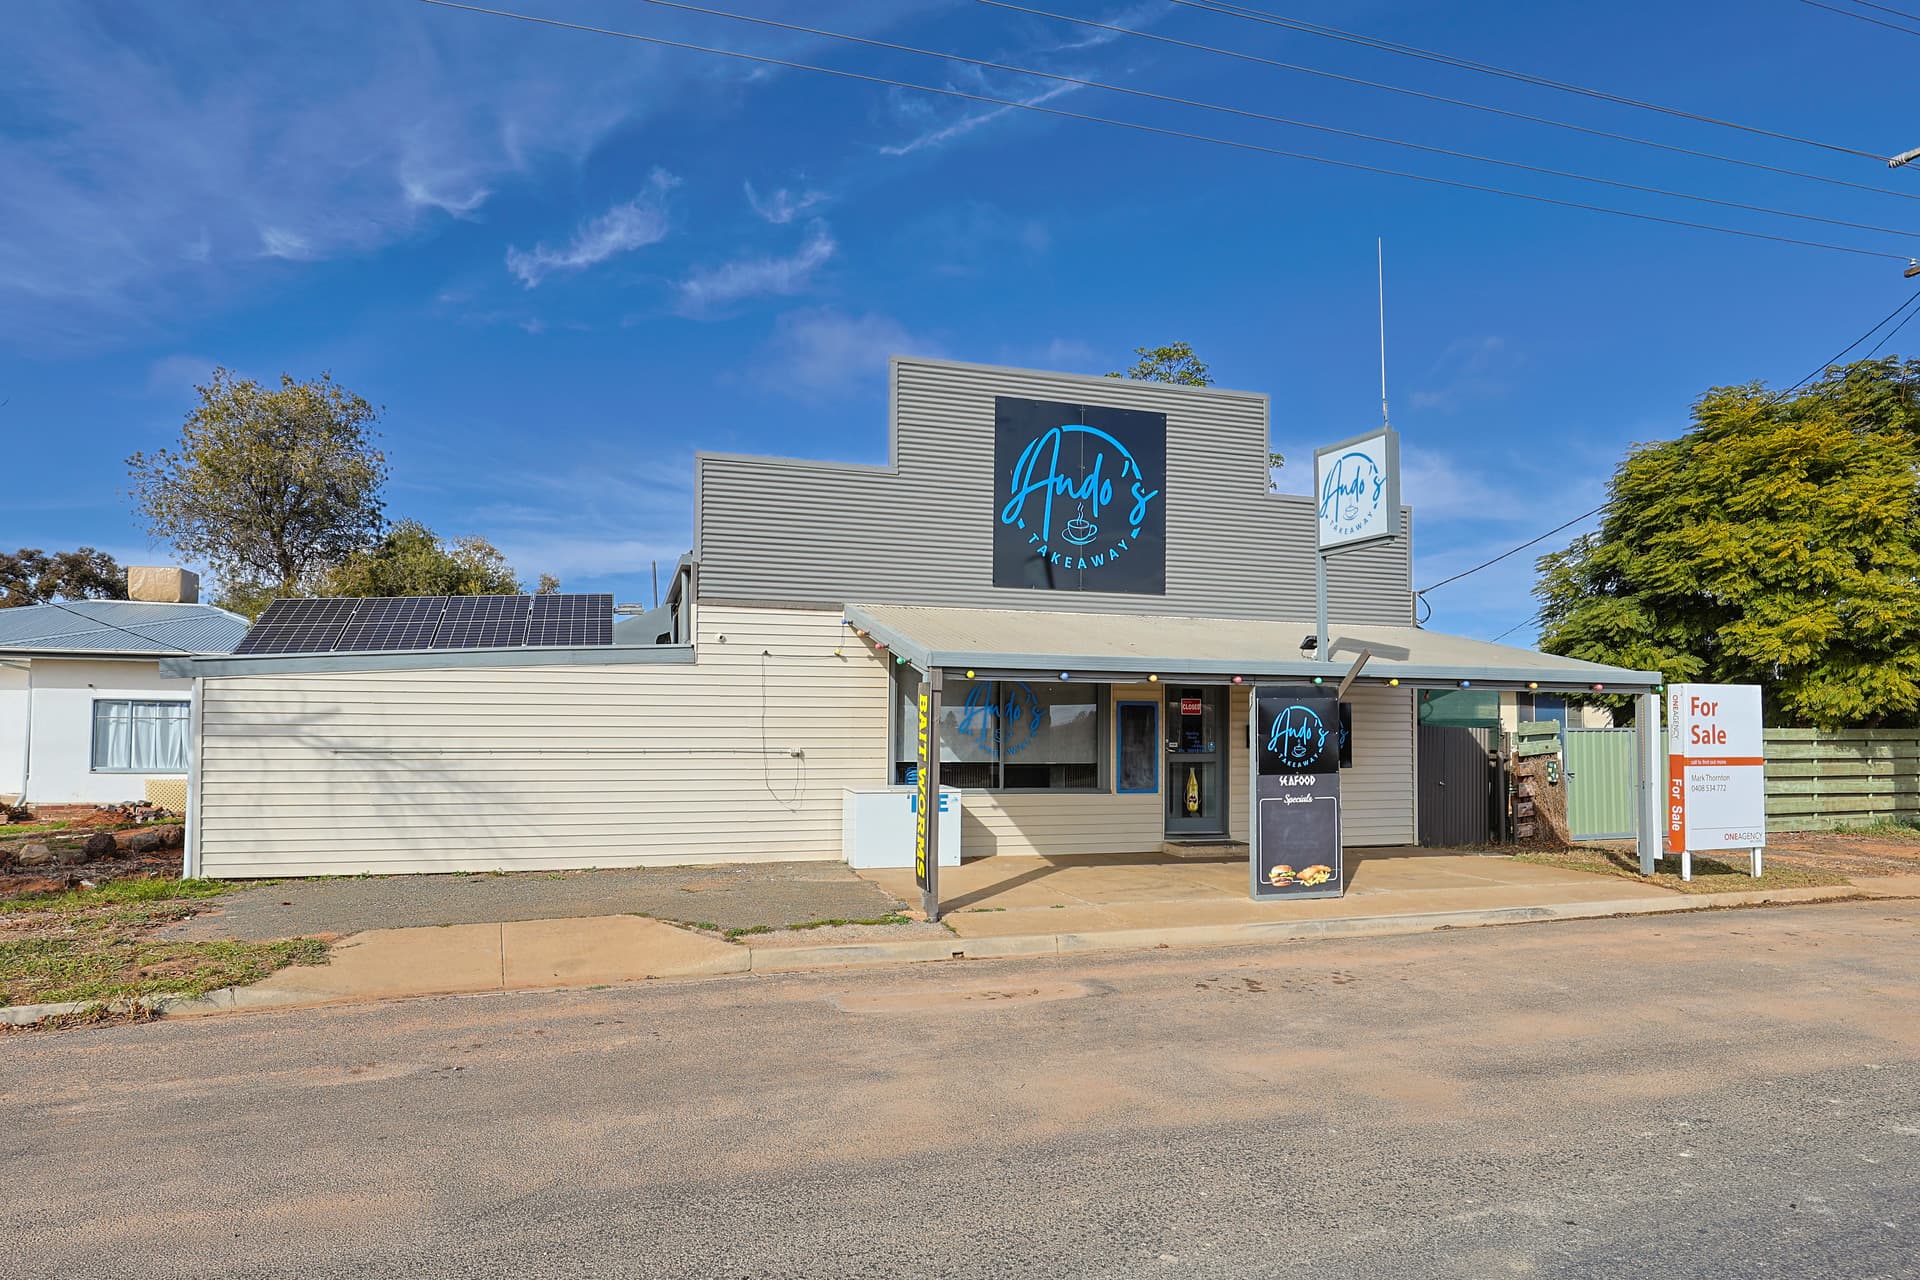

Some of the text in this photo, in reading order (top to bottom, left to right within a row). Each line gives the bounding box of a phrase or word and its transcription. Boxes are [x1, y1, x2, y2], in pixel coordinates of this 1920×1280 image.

[1001, 427, 1159, 542] Ando's
[1320, 458, 1388, 523] Ando's
[1329, 511, 1373, 535] TAKEAWAY
[1028, 532, 1129, 569] TAKEAWAY
[1691, 696, 1718, 717] For
[1267, 707, 1330, 757] Ando's
[1691, 723, 1727, 745] Sale
[1278, 753, 1319, 768] TAKEAWAY
[917, 693, 928, 879] BAIT WORMS
[1279, 775, 1316, 787] SEAFOOD
[1691, 774, 1731, 782] Mark Thornton
[1283, 793, 1314, 806] Specials
[1672, 778, 1683, 831] For Sale
[1723, 831, 1763, 841] ONEAGENCY
